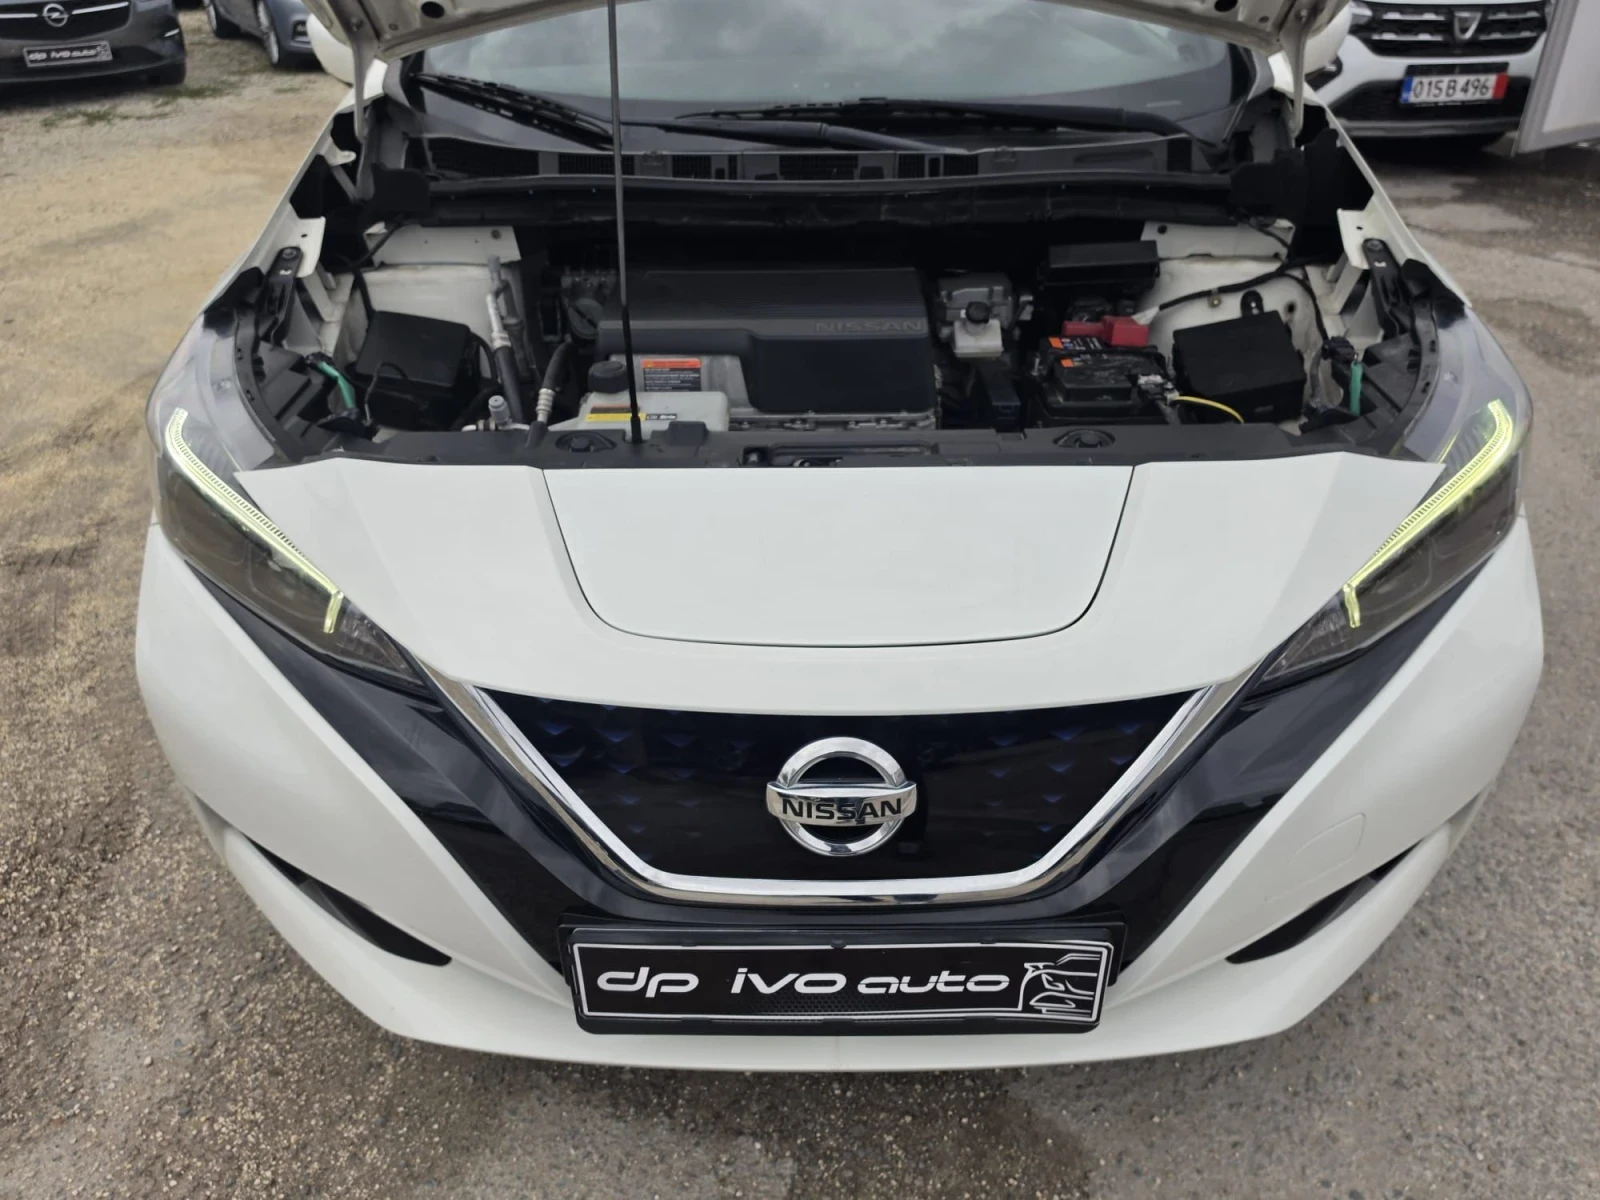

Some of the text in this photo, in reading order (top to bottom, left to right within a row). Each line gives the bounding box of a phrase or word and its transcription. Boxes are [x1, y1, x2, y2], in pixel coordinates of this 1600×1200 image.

[815, 320, 923, 334] NISSAN
[782, 798, 903, 821] NISSAN
[597, 966, 1010, 998] dp ivo auto
